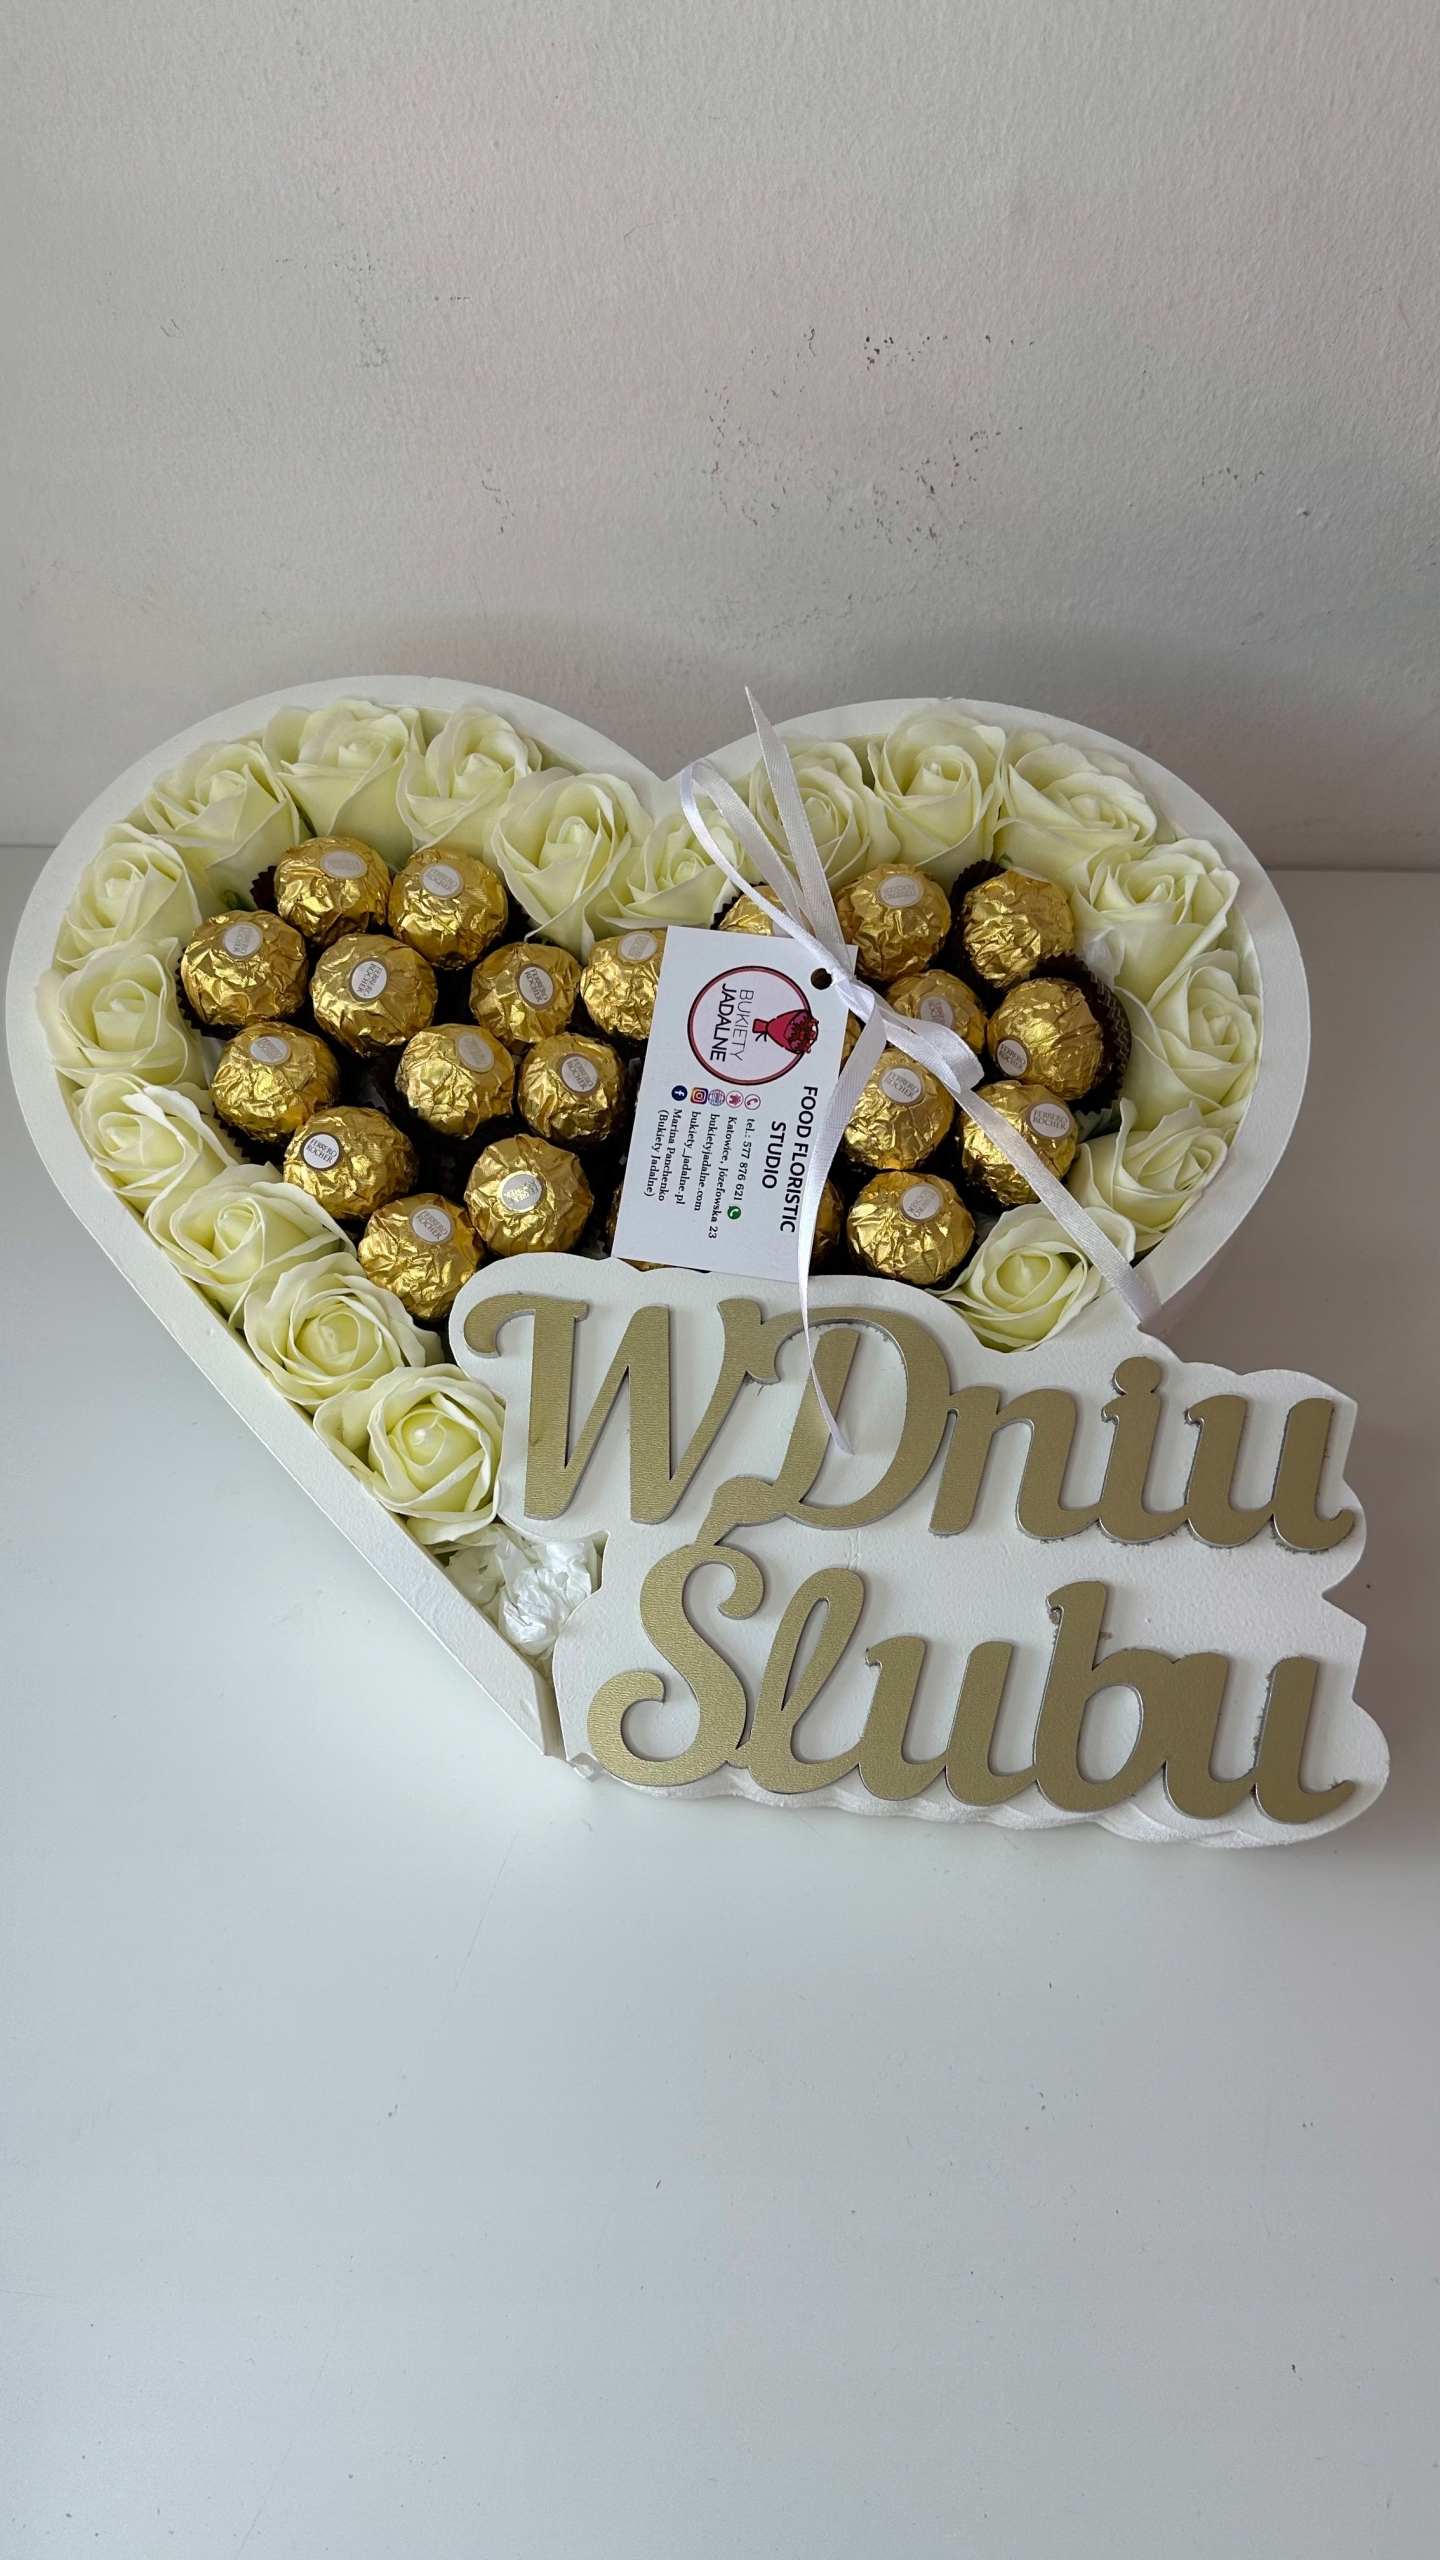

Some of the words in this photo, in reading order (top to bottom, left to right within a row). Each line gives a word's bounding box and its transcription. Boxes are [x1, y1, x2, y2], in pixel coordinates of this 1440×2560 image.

[357, 963, 377, 995] ROCHER
[363, 965, 383, 997] FERRERO
[524, 971, 543, 1004] ROCHER
[531, 968, 549, 1002] FERRERO
[710, 983, 737, 1062] JADALNE
[730, 989, 755, 1061] BUKIETY
[999, 1051, 1023, 1072] ROCHER
[1001, 1044, 1026, 1065] FERRERO
[566, 1061, 588, 1090] ROCHER
[572, 1058, 594, 1087] FERRERO
[890, 1072, 919, 1094] FERRERO
[884, 1077, 915, 1099] ROCHER
[669, 1108, 682, 1144] Marina
[798, 1085, 818, 1139] FOOD
[1033, 1116, 1066, 1131] ROCHER
[1034, 1110, 1067, 1124] FERRERO
[651, 1109, 670, 1153] (Bukiety
[720, 1116, 738, 1164] Katowice,
[744, 1118, 755, 1138] tel.:
[305, 1145, 334, 1164] ROCHER
[310, 1139, 337, 1158] FERRERO
[675, 1110, 701, 1205] bukiety_jadalne.pl
[694, 1113, 720, 1211] bukietyjadalne.com
[743, 1141, 752, 1159] 577
[762, 1120, 787, 1190] STUDIO
[644, 1155, 661, 1197] Jadalne)
[658, 1147, 676, 1202] Panchenko
[738, 1163, 747, 1181] 876
[711, 1166, 729, 1223] Józefowska
[734, 1184, 745, 1201] 621
[780, 1142, 809, 1233] FLORISTIC
[415, 1215, 442, 1240] ROCHER
[421, 1210, 448, 1236] FERRERO
[708, 1226, 718, 1239] 23
